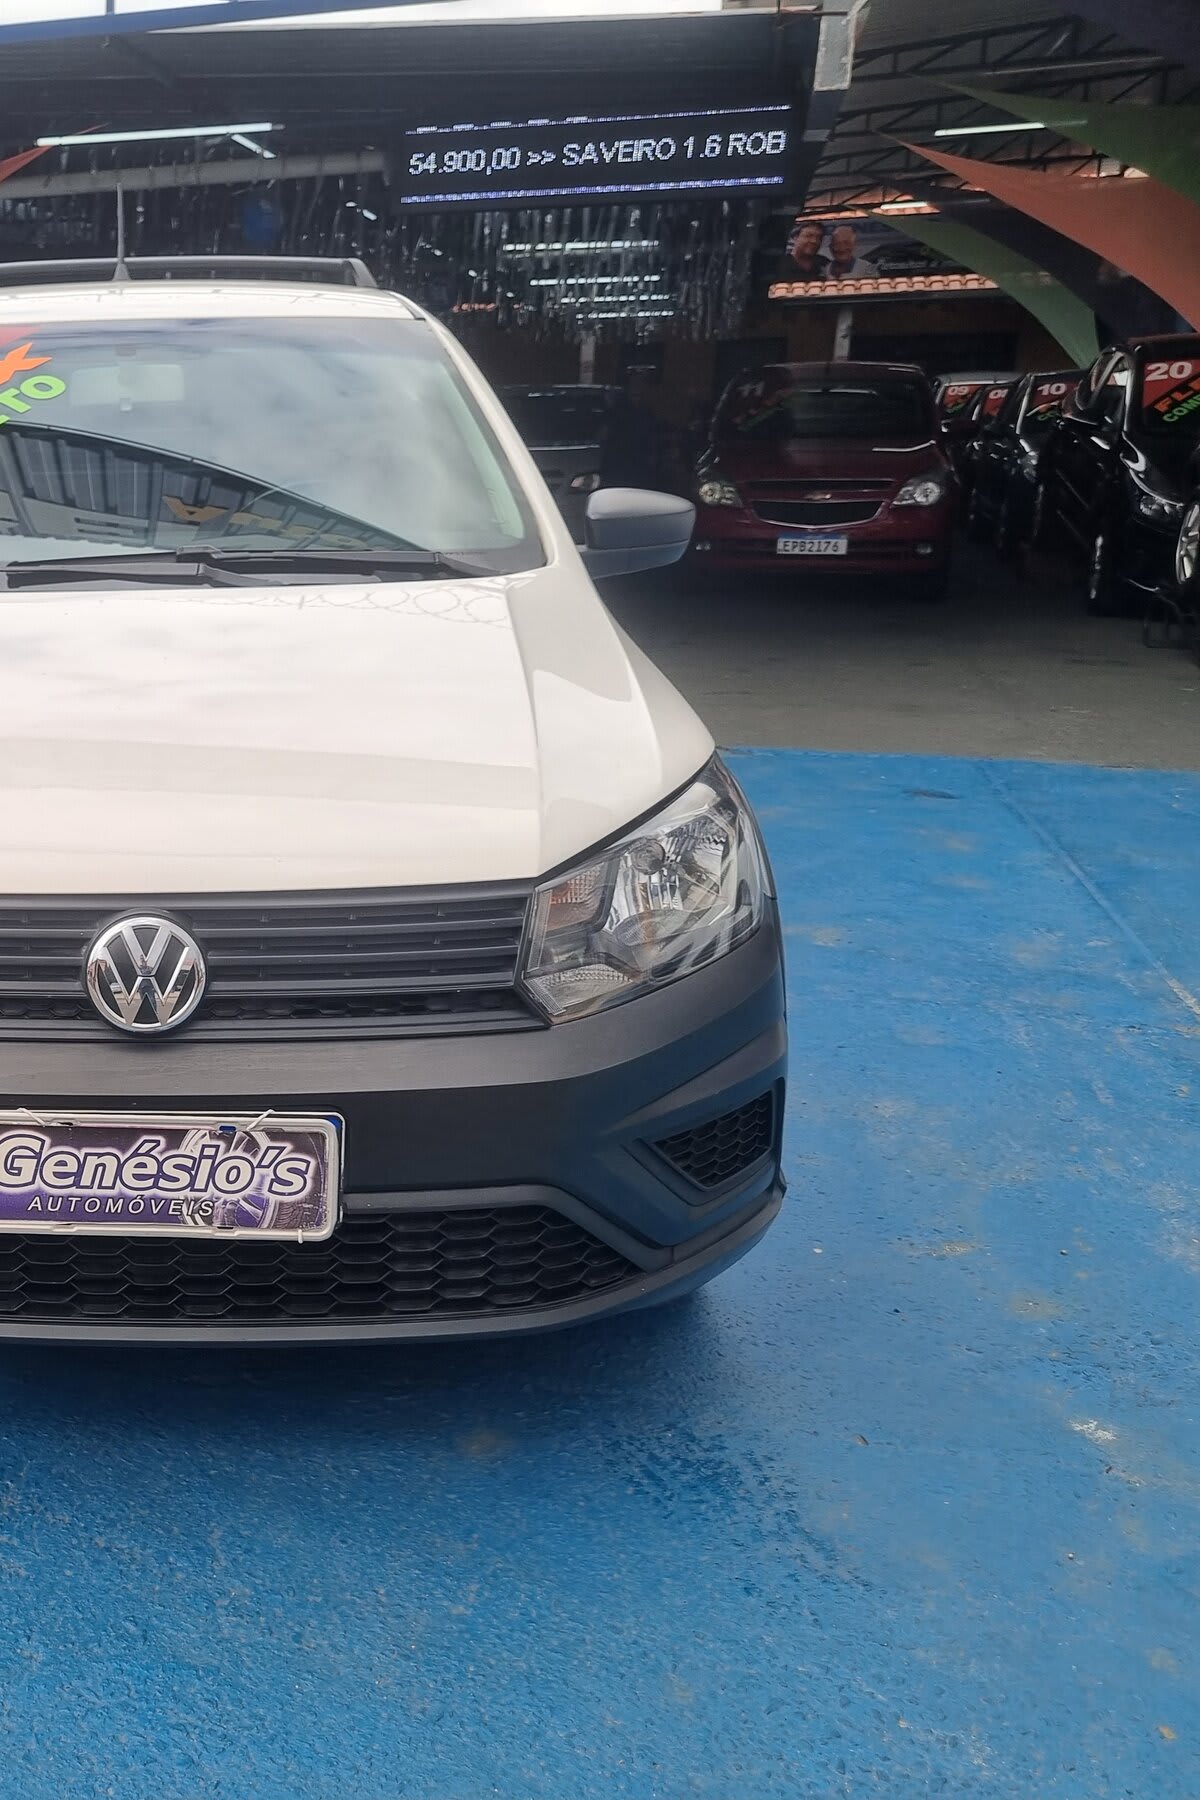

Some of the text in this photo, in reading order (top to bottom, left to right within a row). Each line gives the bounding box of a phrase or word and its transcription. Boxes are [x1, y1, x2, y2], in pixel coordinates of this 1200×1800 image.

[408, 146, 521, 176] 54.900,00
[561, 136, 676, 167] SAVEIRO
[683, 132, 721, 160] 1.6
[1145, 360, 1193, 382] 20
[1036, 382, 1067, 396] 10
[782, 540, 839, 553] EPB2176
[28, 1194, 216, 1217] AUTOMÓVEIS
